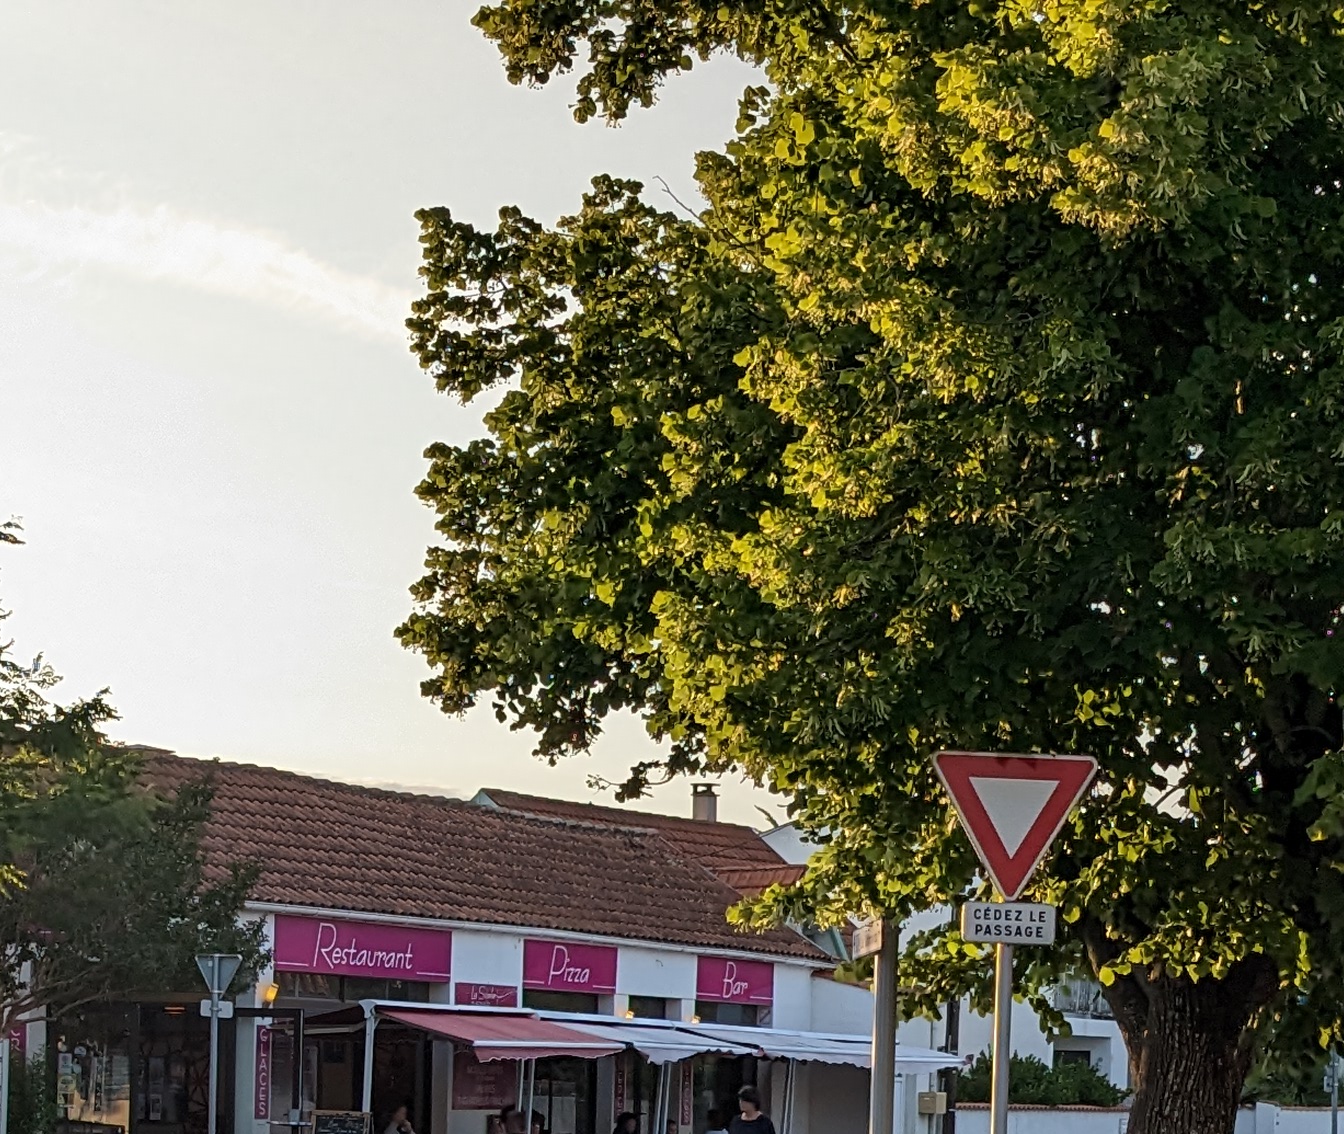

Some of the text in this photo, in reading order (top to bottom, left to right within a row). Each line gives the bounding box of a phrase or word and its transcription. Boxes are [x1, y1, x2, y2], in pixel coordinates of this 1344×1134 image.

[973, 906, 1046, 923] CÉDEZ LE
[974, 924, 1044, 938] PASSAGE
[313, 922, 414, 972] Restaurant
[547, 945, 591, 985] Pizza
[722, 961, 748, 998] Bar
[258, 1028, 269, 1116] GLACES
